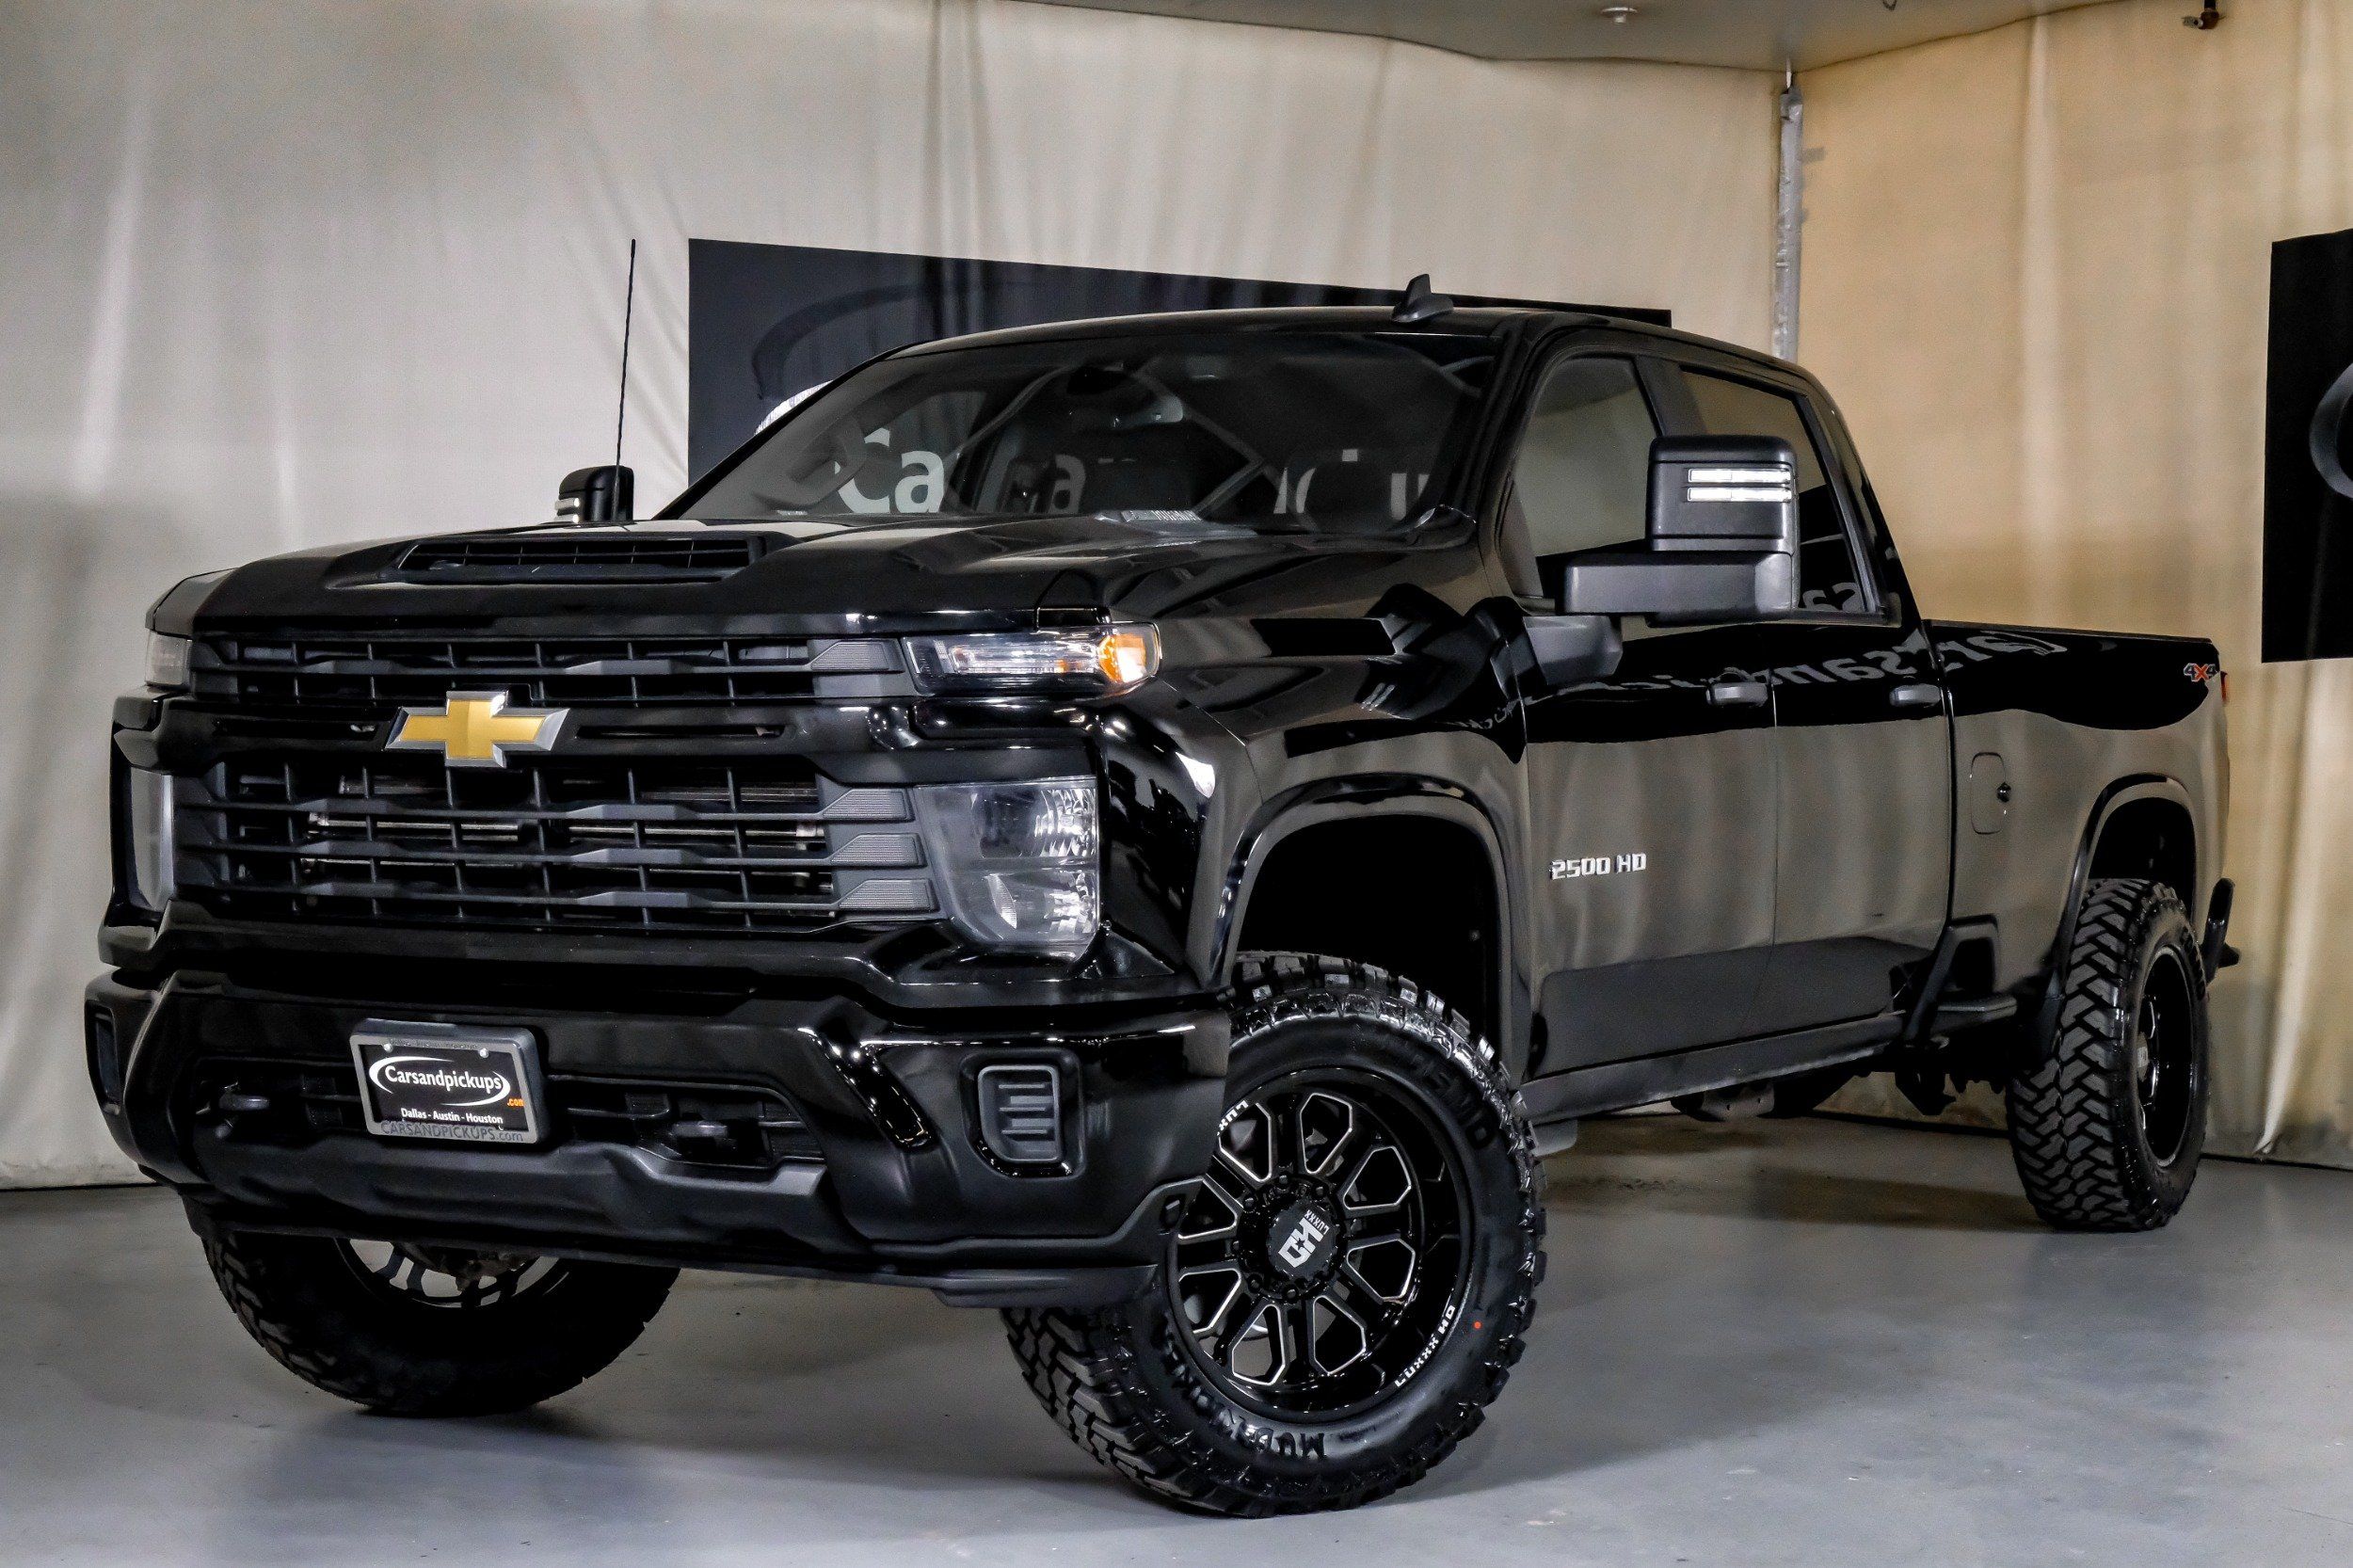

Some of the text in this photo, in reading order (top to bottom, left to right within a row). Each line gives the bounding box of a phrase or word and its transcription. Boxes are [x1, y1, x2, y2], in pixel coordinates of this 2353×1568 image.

[1550, 854, 1647, 880] 2500 HD
[384, 1065, 503, 1094] Carsandpickups
[400, 1108, 426, 1119] Dallas
[433, 1110, 460, 1122] Austin
[466, 1112, 504, 1124] Houston
[380, 1120, 523, 1142] CARSANDPICKUPS.com
[1304, 1209, 1330, 1235] LUXXX
[1394, 1304, 1456, 1387] LUXXX HD
